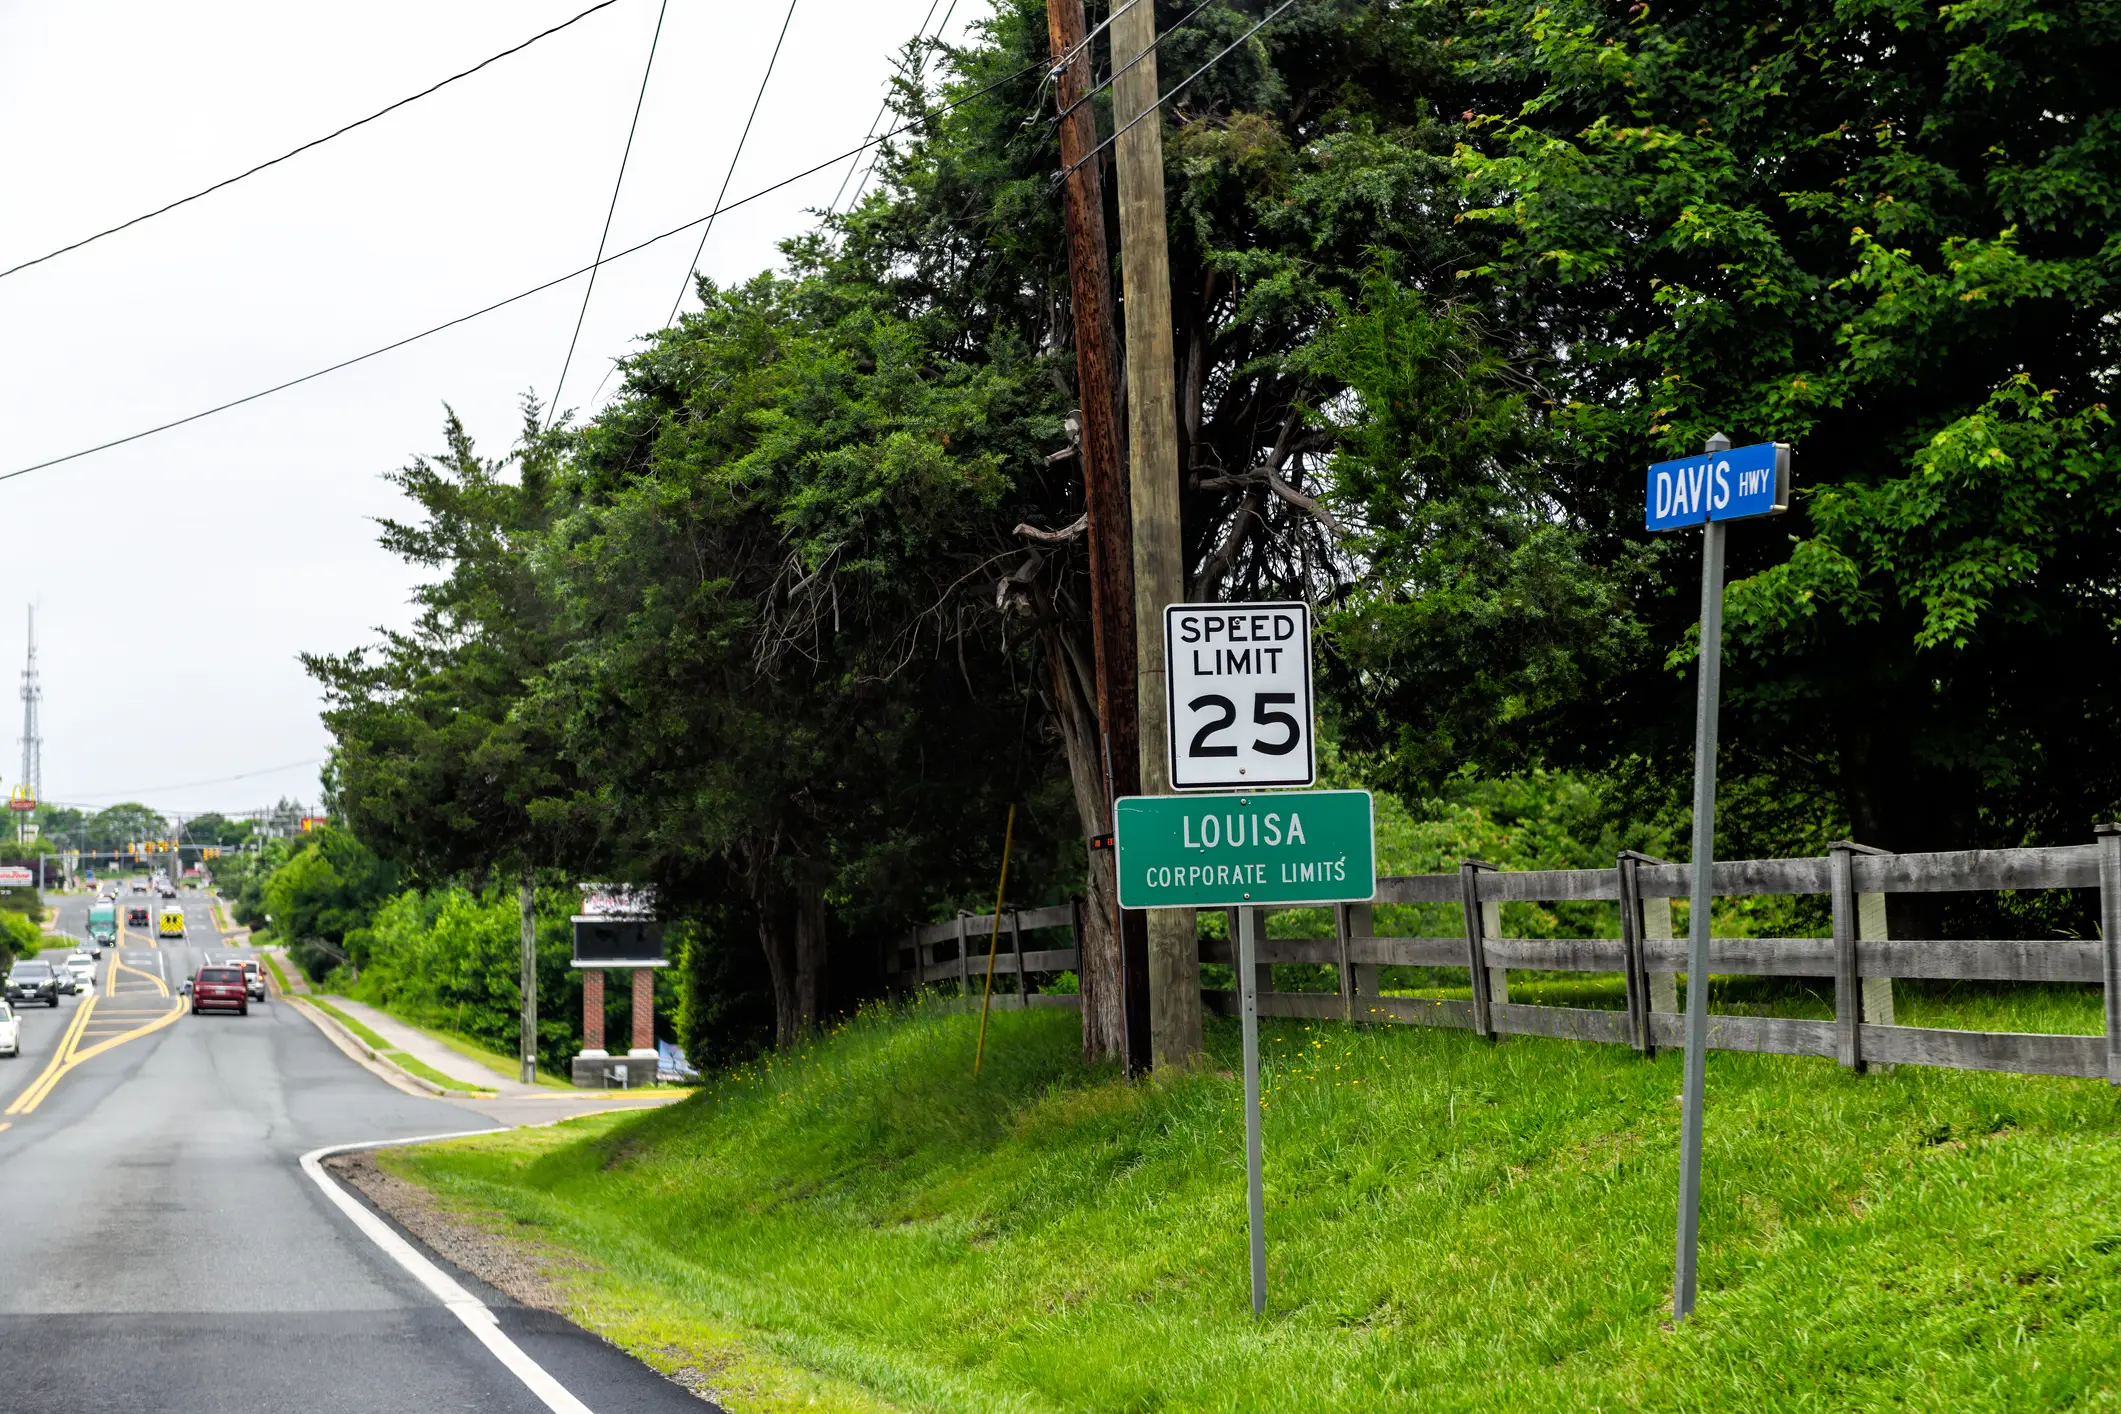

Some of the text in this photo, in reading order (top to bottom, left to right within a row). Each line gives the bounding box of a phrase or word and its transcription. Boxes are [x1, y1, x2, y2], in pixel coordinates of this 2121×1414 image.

[1656, 460, 1770, 519] DAVIS HWY
[1180, 615, 1294, 643] SPEED
[1193, 648, 1283, 675] LIMIT
[1188, 692, 1301, 758] 25
[1183, 813, 1306, 848] LOUISA
[1146, 859, 1346, 887] CORPORATE LIMITS
